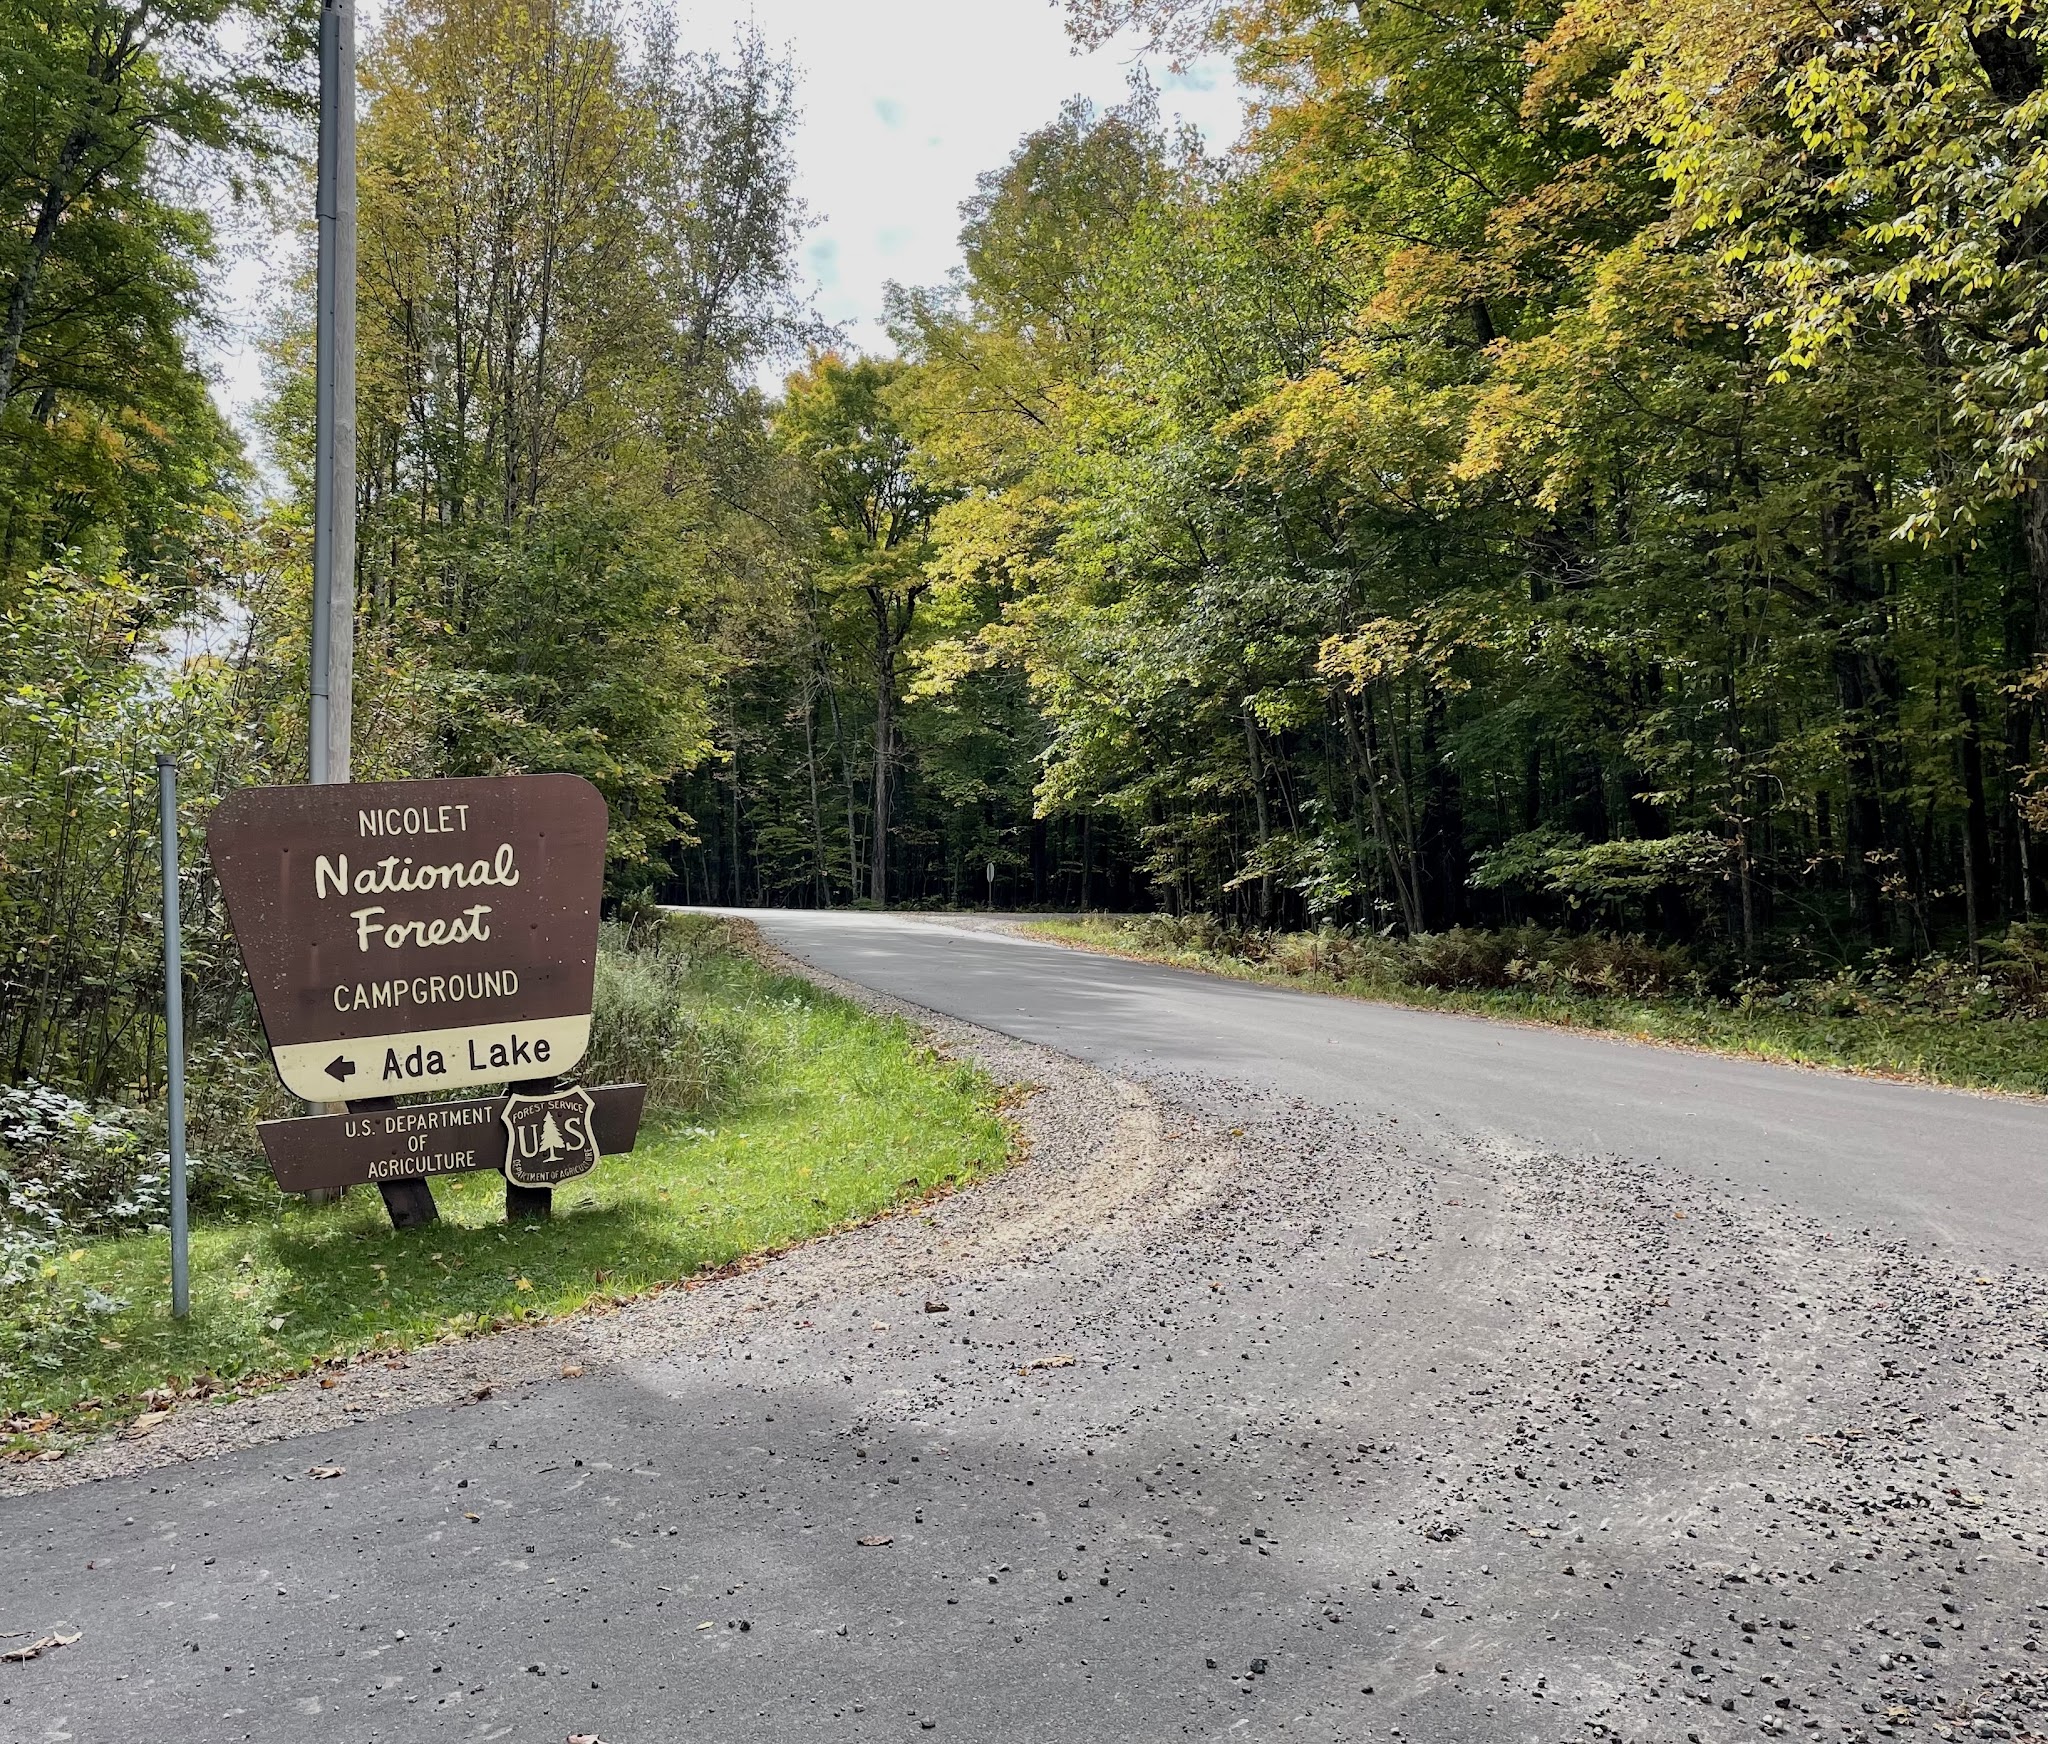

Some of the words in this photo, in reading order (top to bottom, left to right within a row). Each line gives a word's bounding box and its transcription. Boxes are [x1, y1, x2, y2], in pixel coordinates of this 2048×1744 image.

[358, 804, 470, 837] NICOLET
[314, 843, 520, 899] National
[350, 904, 493, 952] Forest
[333, 969, 519, 1012] CAMPGROUND
[382, 1045, 447, 1080] Ada
[468, 1034, 551, 1071] Lake
[345, 1120, 376, 1138] U.S.
[385, 1106, 493, 1133] DEPARTMENT
[512, 1103, 545, 1123] FOREST
[548, 1101, 584, 1113] SERVICE
[407, 1134, 428, 1152] OF
[368, 1150, 476, 1179] AGRICULTURE
[513, 1159, 550, 1181] DEPARTMENT
[560, 1148, 593, 1177] AGRICULTURE
